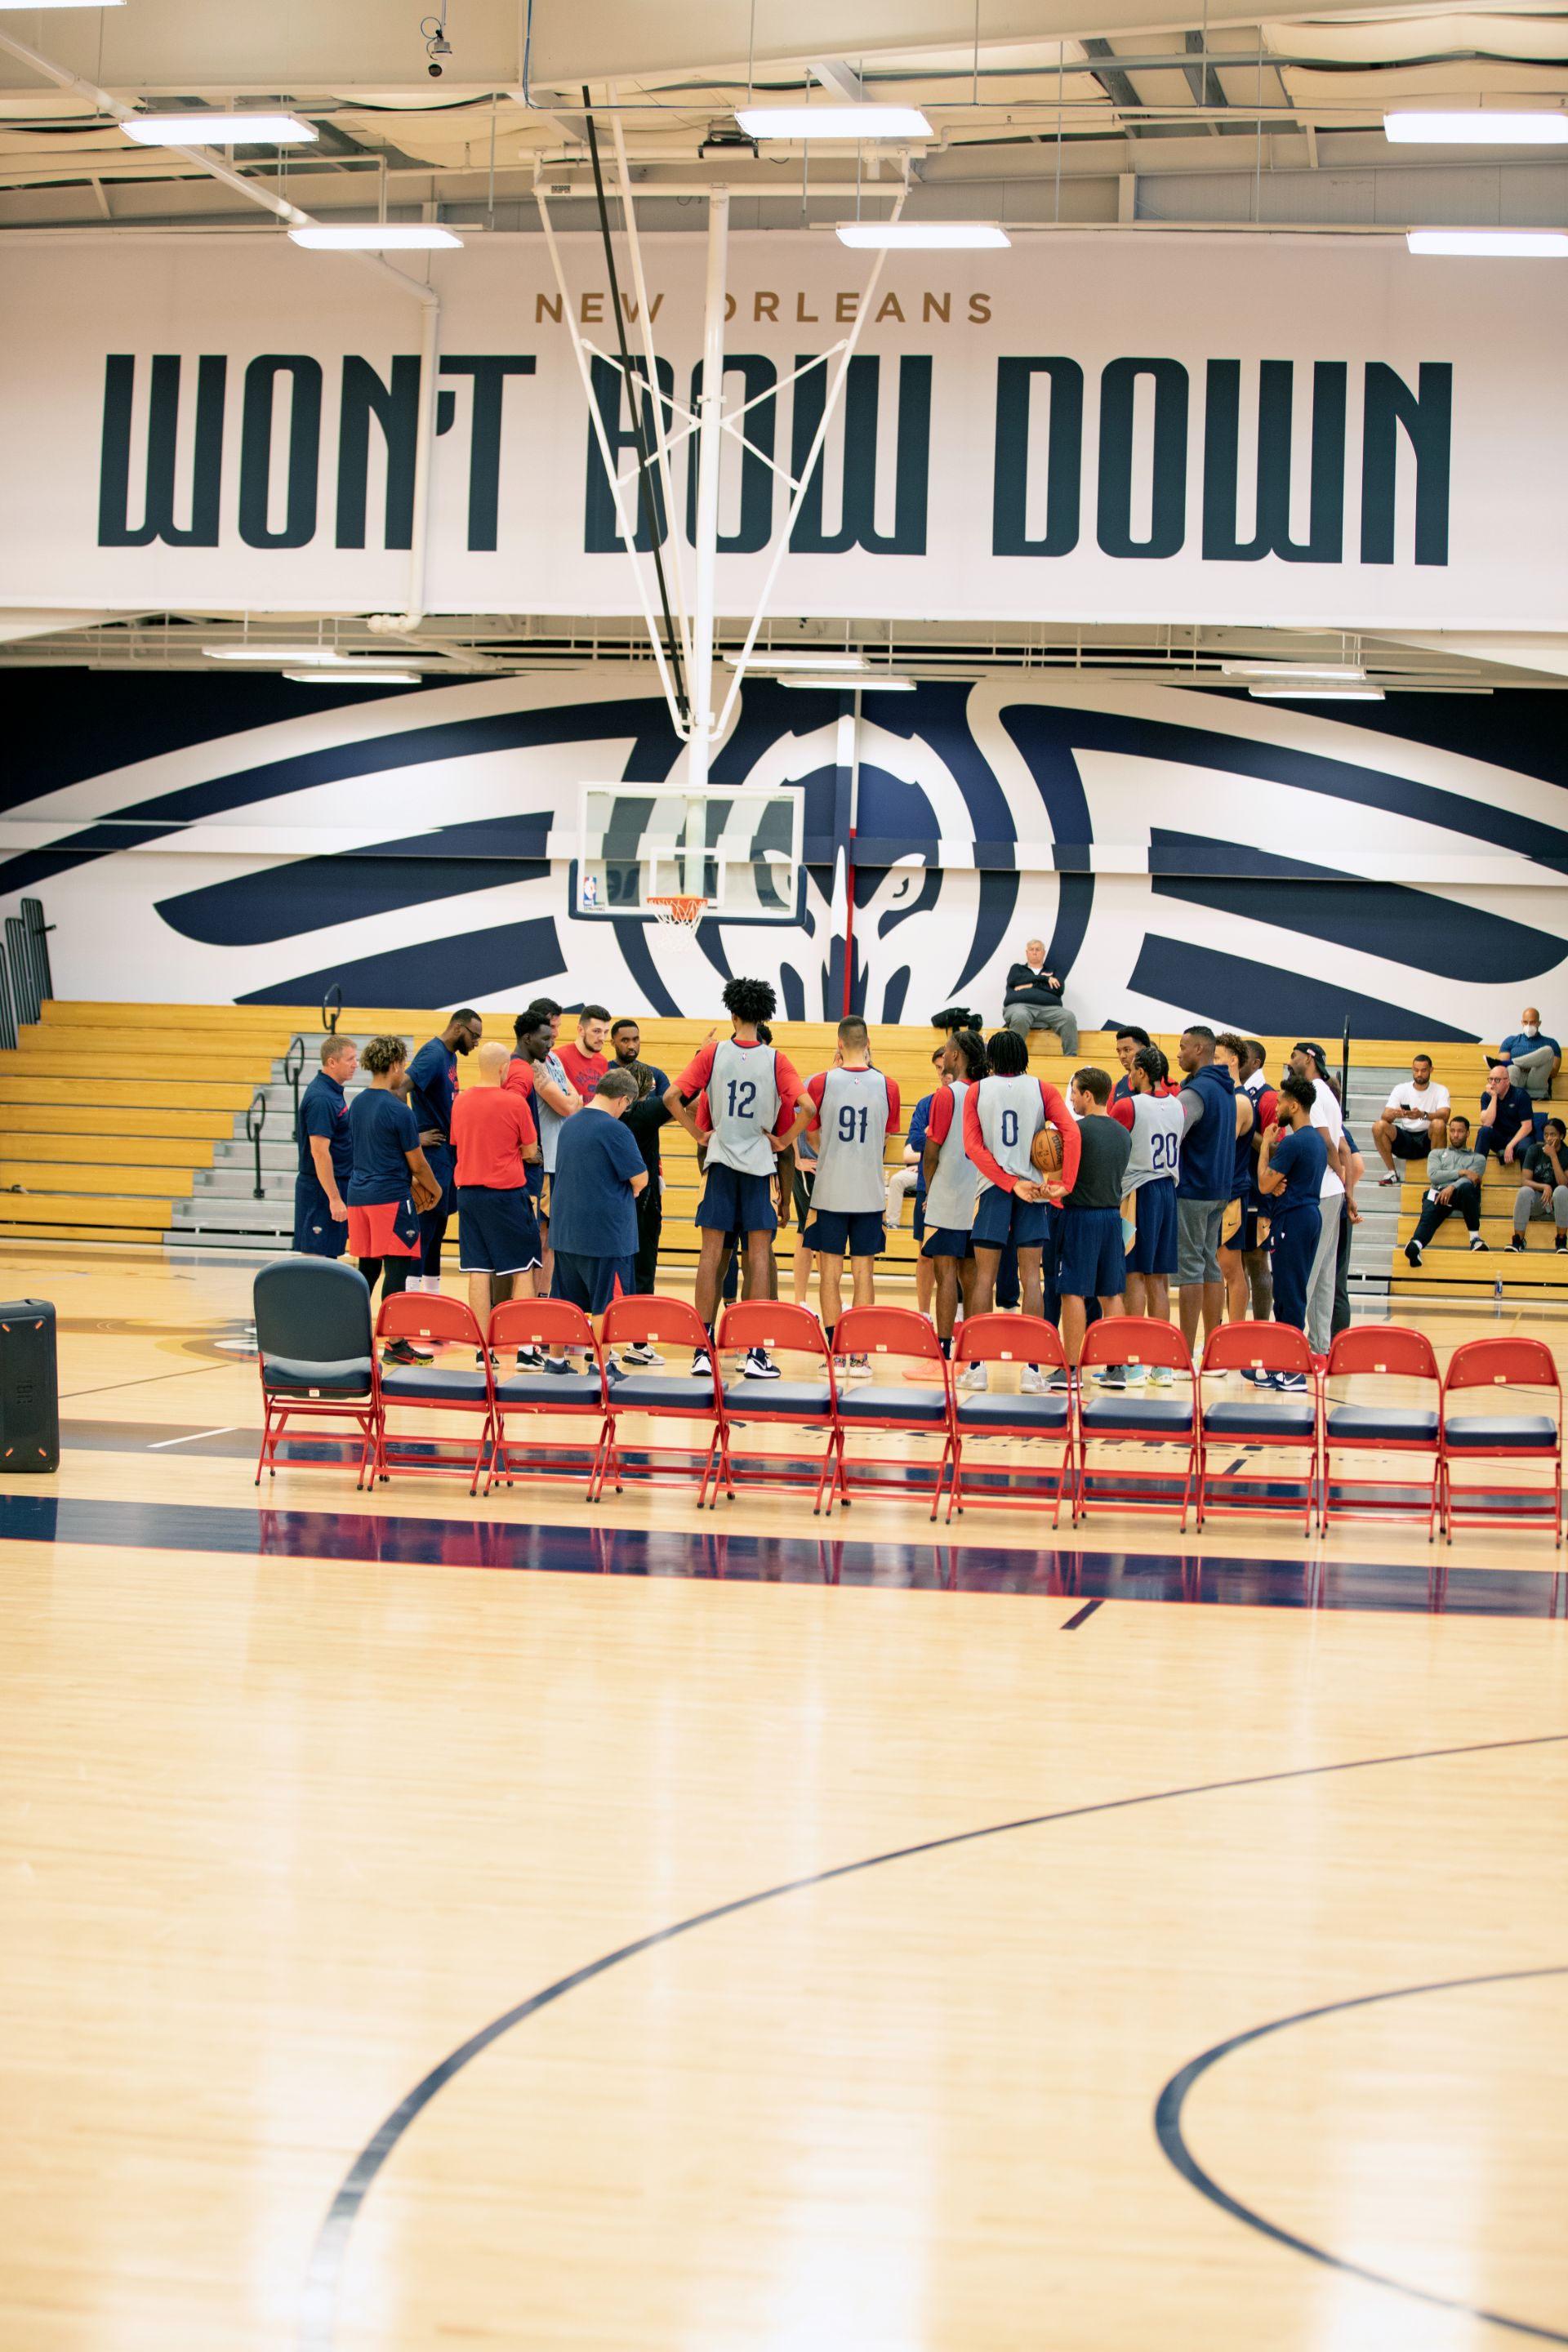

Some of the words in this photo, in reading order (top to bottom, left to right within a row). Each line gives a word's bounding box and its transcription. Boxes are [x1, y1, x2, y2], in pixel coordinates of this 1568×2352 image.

[536, 293, 665, 323] NEW
[98, 354, 537, 552] WON'T
[584, 354, 933, 556] BOW
[992, 356, 1453, 566] DOWN
[727, 1079, 756, 1119] 12
[838, 1105, 868, 1143] 91
[1001, 1109, 1019, 1147] 0
[1151, 1132, 1178, 1169] 20
